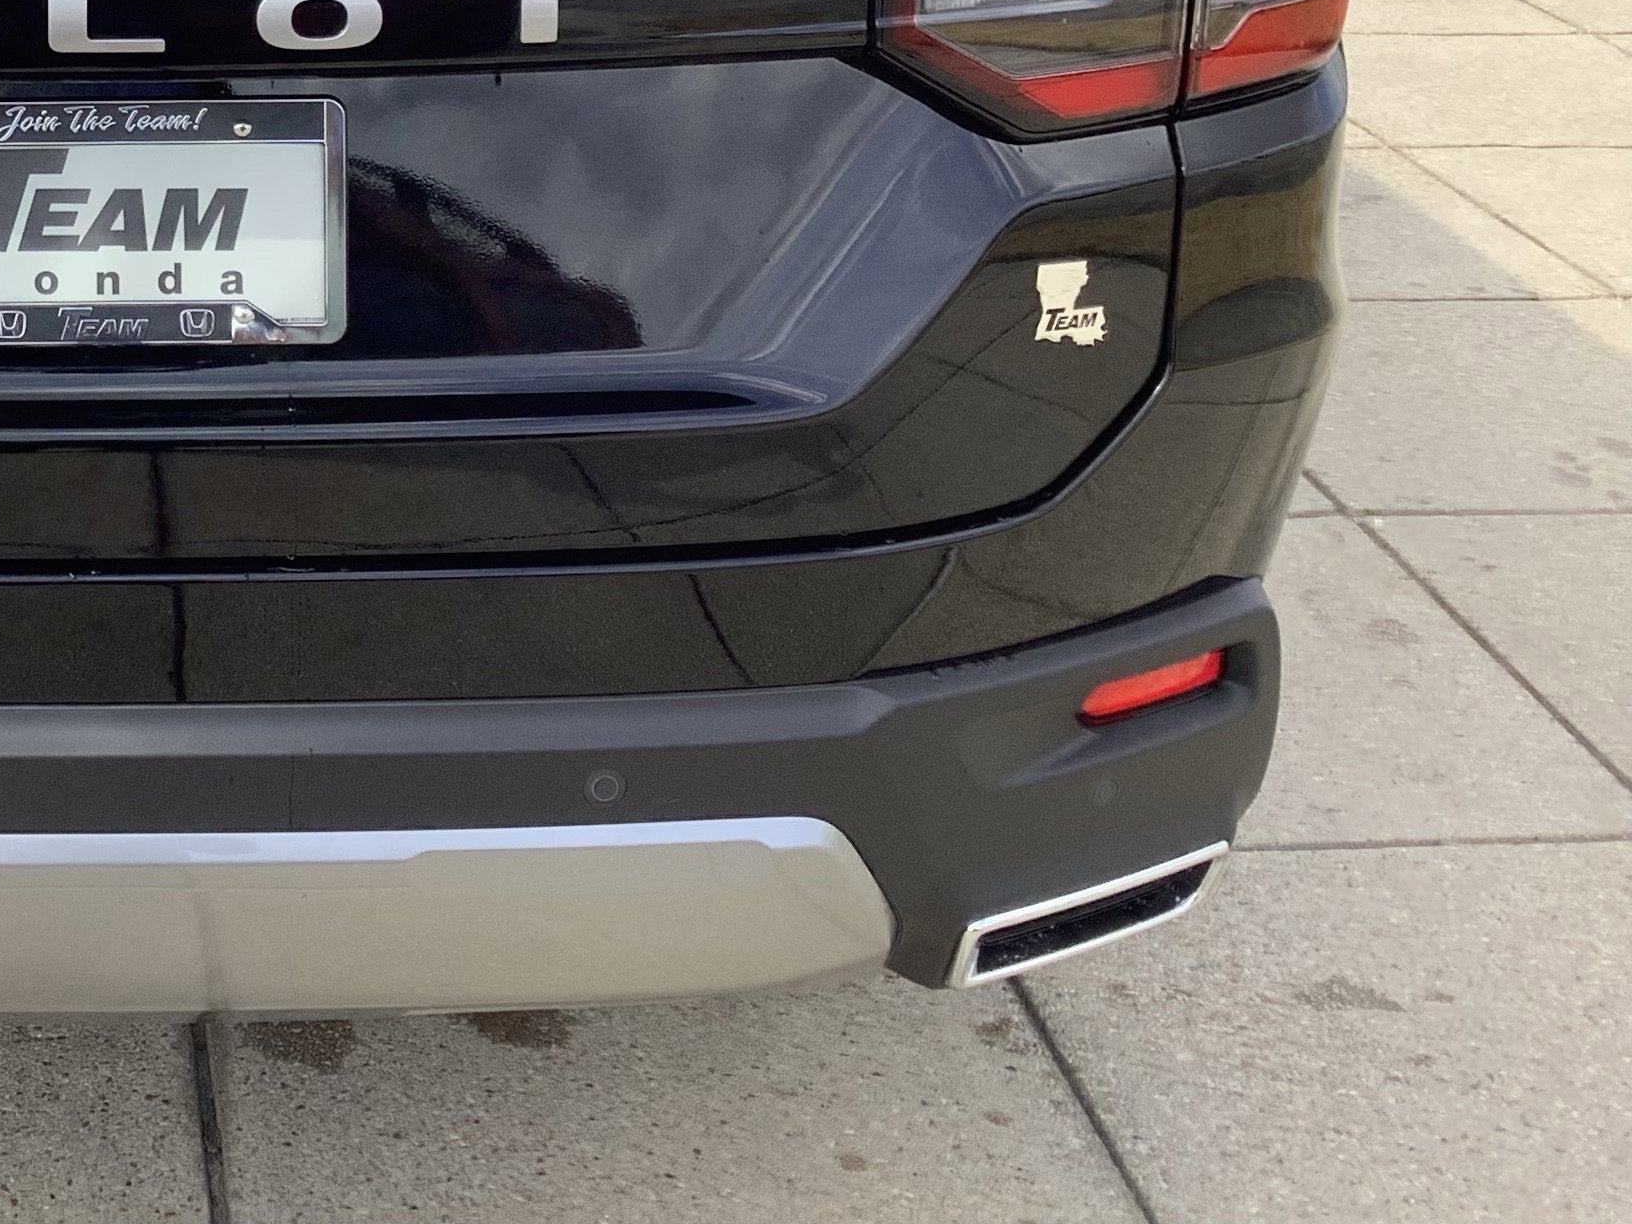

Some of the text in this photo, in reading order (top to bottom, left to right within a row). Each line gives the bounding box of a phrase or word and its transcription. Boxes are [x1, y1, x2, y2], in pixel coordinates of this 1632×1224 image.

[63, 105, 116, 133] The
[118, 105, 209, 133] Team!
[57, 306, 149, 341] TEAM
[1044, 307, 1099, 333] TEAM
